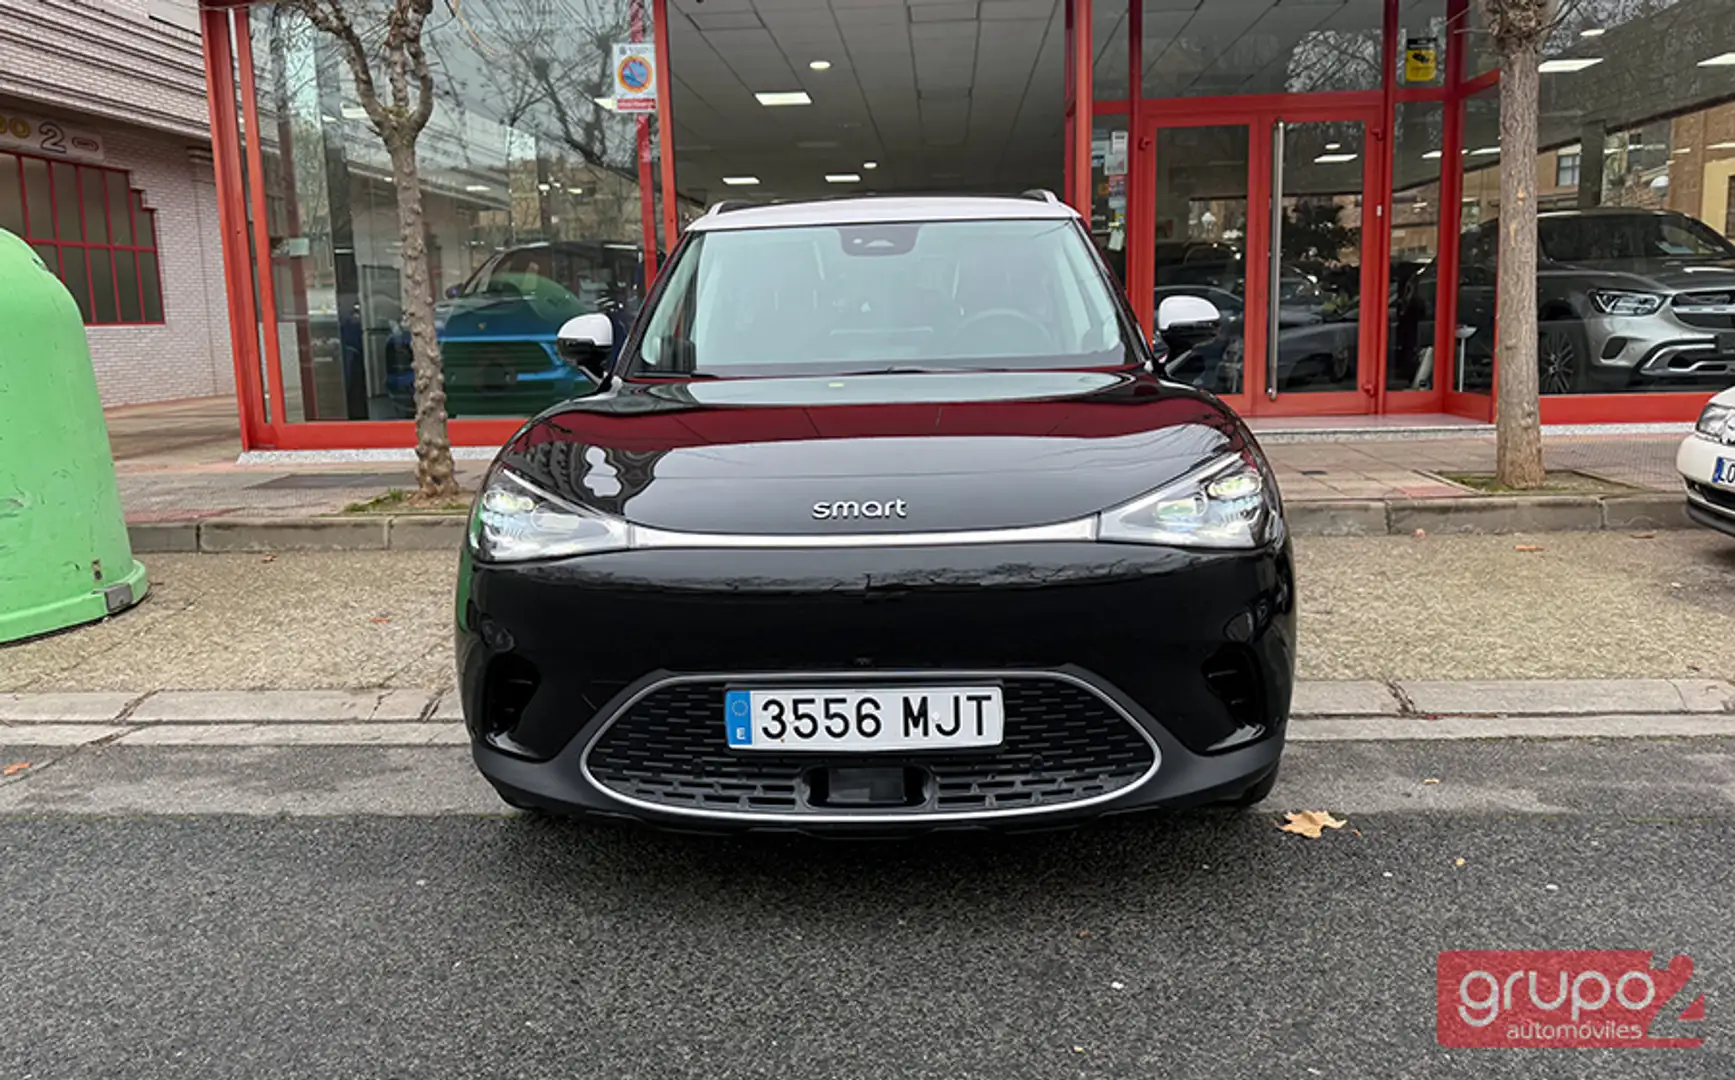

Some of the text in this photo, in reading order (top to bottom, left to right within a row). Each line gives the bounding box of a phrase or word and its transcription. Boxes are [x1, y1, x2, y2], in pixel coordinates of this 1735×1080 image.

[38, 121, 67, 154] 2
[812, 499, 908, 520] smart
[761, 694, 993, 740] 3556 MJT
[736, 727, 746, 740] E
